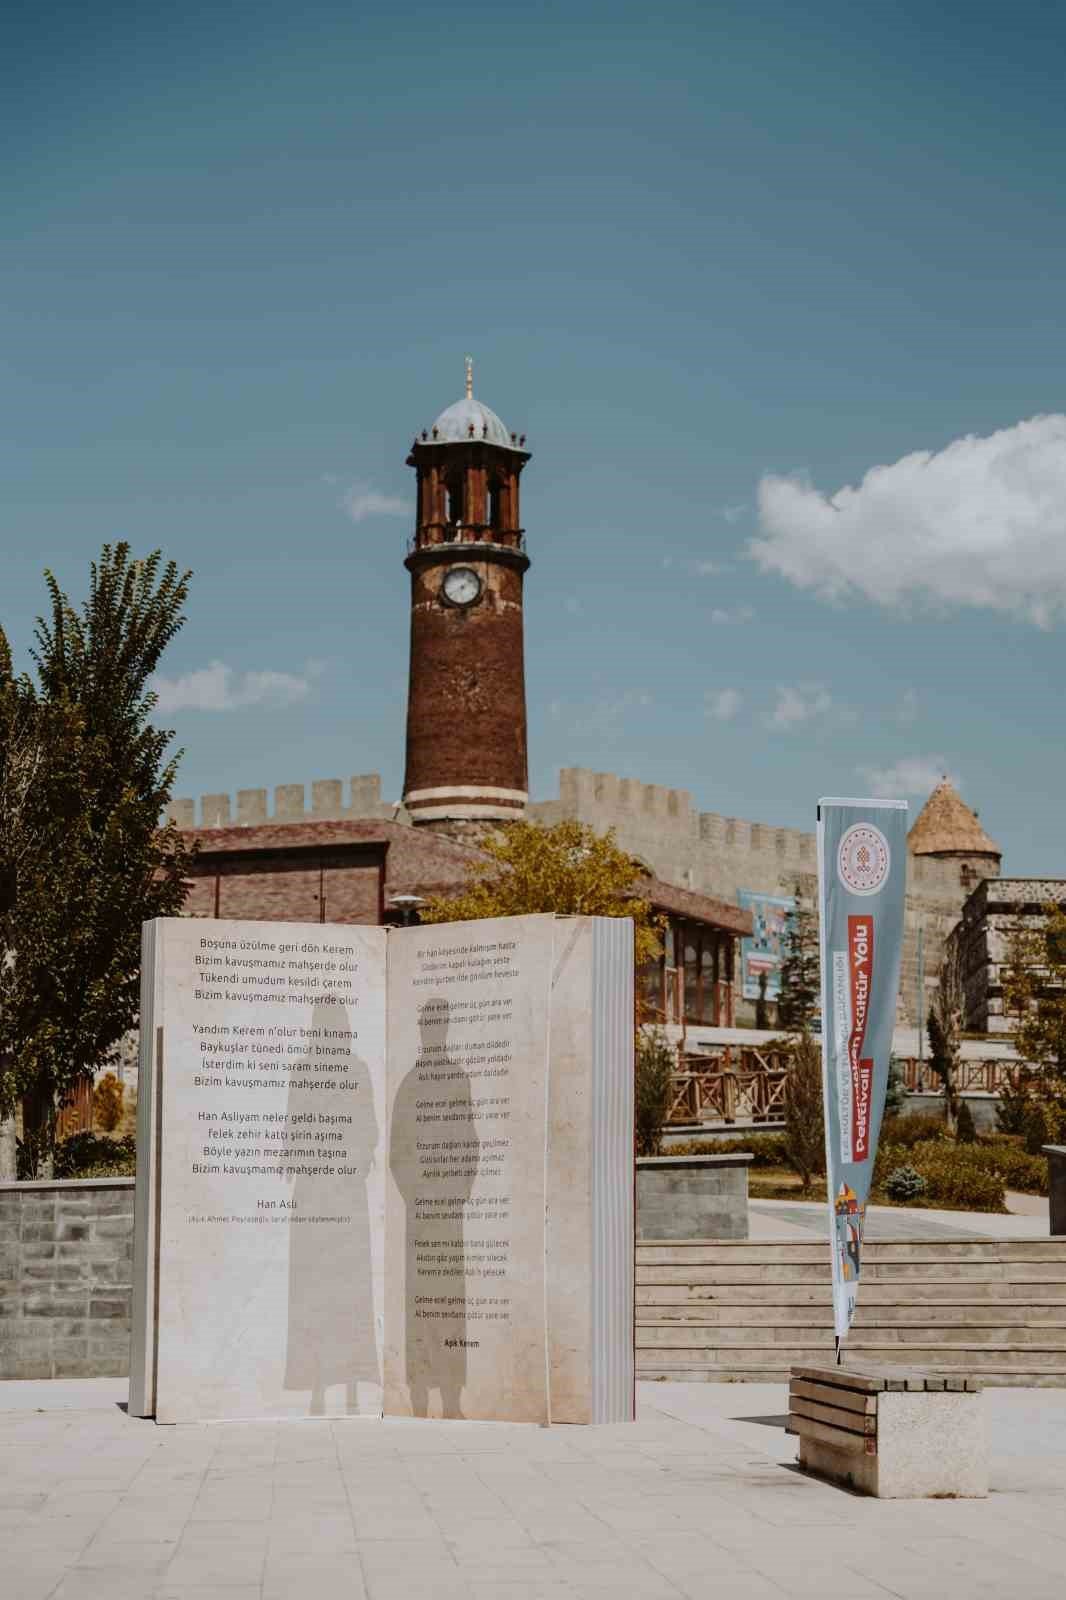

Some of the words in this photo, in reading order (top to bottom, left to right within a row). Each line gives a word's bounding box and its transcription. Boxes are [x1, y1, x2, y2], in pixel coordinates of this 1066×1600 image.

[200, 938, 237, 950] Boşuna
[240, 941, 275, 952] üzülme
[279, 943, 298, 954] geri
[301, 943, 320, 953] dön
[323, 945, 353, 955] Kerem
[854, 925, 868, 967] Yolu
[195, 956, 222, 965] Bizim
[289, 959, 336, 971] mahşerde
[339, 962, 358, 971] olur
[200, 973, 239, 983] Tükendi
[242, 976, 285, 985] umudum
[323, 979, 352, 989] çarem
[195, 990, 222, 999] Bizim
[289, 994, 336, 1005] mahşerde
[339, 996, 358, 1005] olur
[855, 970, 868, 1032] Kültür
[193, 1024, 229, 1035] Yandım
[233, 1027, 265, 1036] Kerem
[300, 1028, 321, 1037] beni
[324, 1029, 358, 1039] kınama
[201, 1042, 248, 1053] Baykuşlar
[287, 1045, 312, 1054] ömür
[316, 1045, 350, 1056] binama
[247, 1060, 256, 1069] ki
[259, 1061, 279, 1071] seni
[282, 1063, 311, 1072] saram
[314, 1062, 349, 1072] sineme
[195, 1077, 222, 1086] Bizim
[289, 1080, 336, 1092] mahşerde
[339, 1080, 358, 1090] olur
[199, 1112, 218, 1121] Han
[263, 1113, 288, 1122] neler
[291, 1113, 316, 1124] geldi
[319, 1114, 352, 1125] başıma
[208, 1129, 233, 1139] Felek
[237, 1129, 261, 1139] zehir
[203, 1146, 232, 1158] Böyle
[193, 1164, 220, 1173] Bizim
[286, 1165, 334, 1176] mahşerde
[337, 1165, 357, 1175] olur
[257, 1200, 276, 1208] Han
